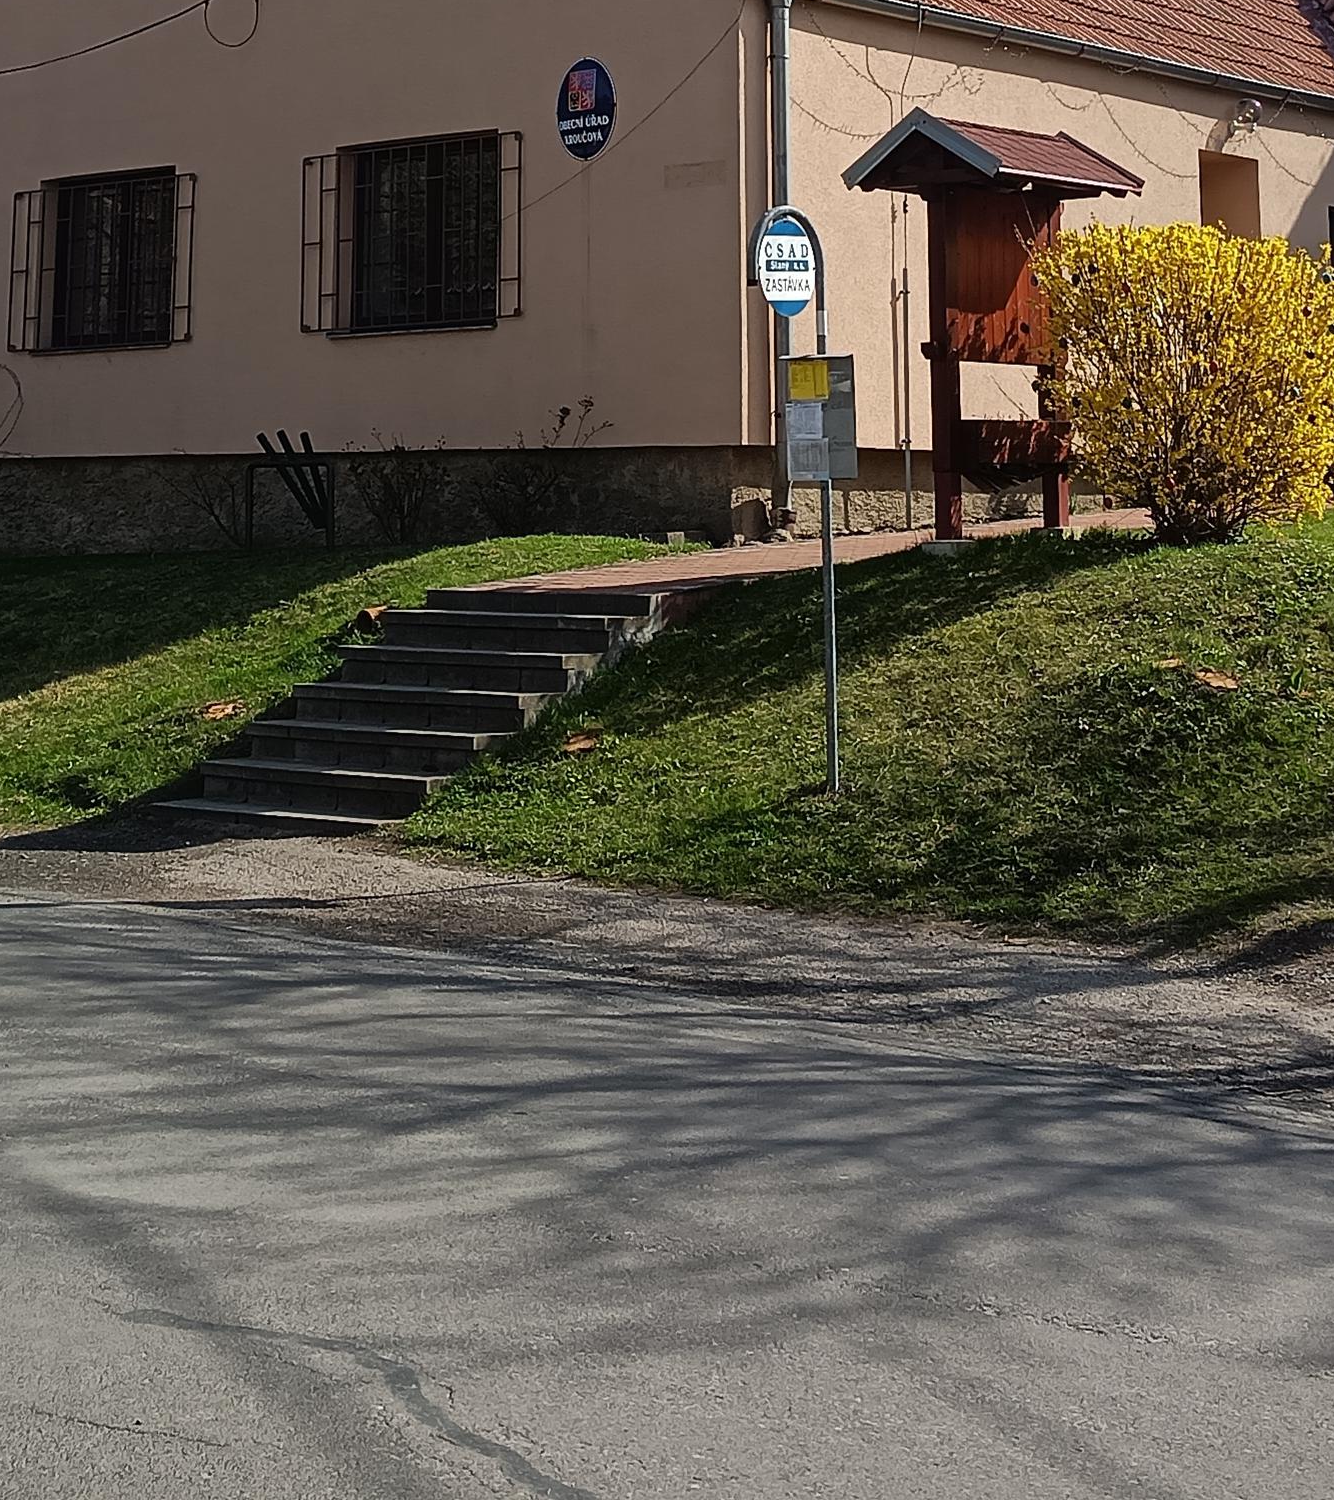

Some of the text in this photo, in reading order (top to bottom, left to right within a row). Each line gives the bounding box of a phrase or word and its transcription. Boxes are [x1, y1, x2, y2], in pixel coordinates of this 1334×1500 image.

[559, 114, 609, 130] OBECNÍ ÚŘAD
[765, 276, 810, 292] ZASTÁVKA
